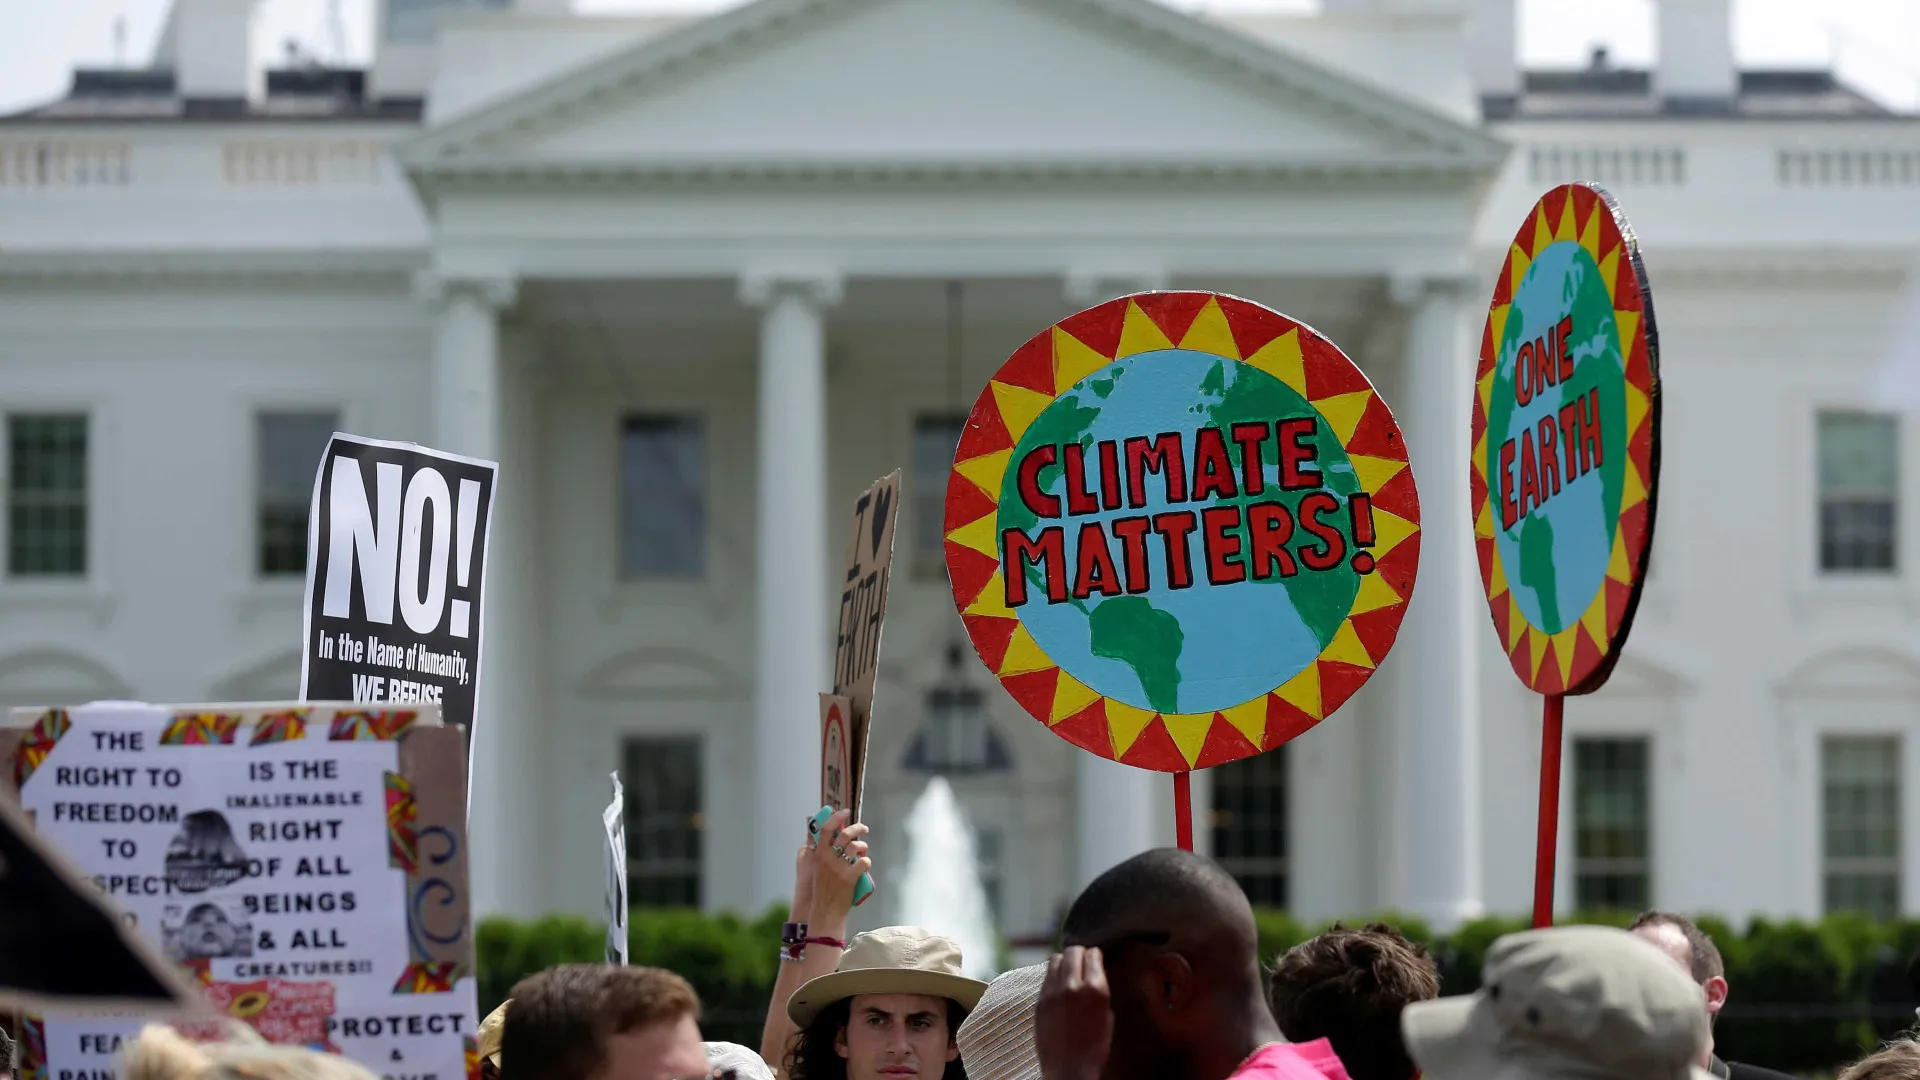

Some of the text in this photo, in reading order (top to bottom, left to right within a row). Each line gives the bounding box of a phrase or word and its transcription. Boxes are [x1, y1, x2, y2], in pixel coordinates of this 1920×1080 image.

[1514, 314, 1574, 408] ONE
[1017, 417, 1323, 518] CLIMATE
[1499, 386, 1603, 532] EARTH
[323, 455, 481, 638] NO!
[1002, 492, 1376, 608] MATTERS!
[318, 630, 469, 685] In the Name of Humanity,
[352, 673, 443, 706] WE REFUSE
[92, 731, 144, 751] THE
[57, 768, 182, 787] RIGHT TO
[250, 761, 337, 780] IS THE
[227, 793, 363, 808] INALIENABLE
[54, 804, 178, 823] FREEDOM
[250, 822, 342, 841] RIGHT
[103, 841, 137, 858] TO
[247, 857, 351, 877] OF ALL
[244, 894, 356, 913] BEINGS
[258, 930, 347, 950] & ALL
[326, 1014, 464, 1036] PROTECT
[390, 1048, 403, 1061] &
